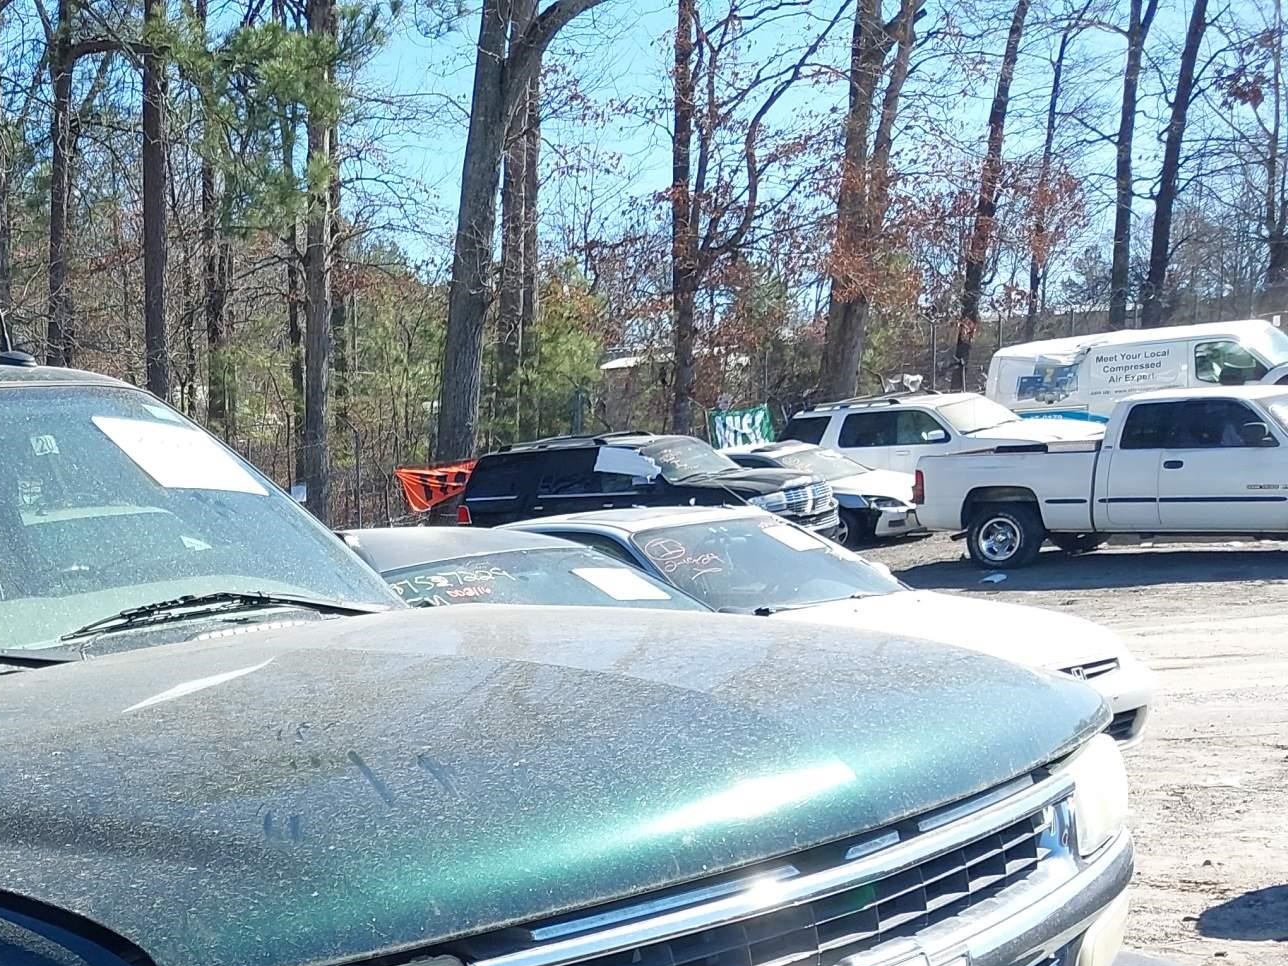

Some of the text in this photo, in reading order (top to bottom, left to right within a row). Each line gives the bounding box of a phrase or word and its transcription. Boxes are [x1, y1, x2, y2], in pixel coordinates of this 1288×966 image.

[1144, 349, 1170, 358] Local
[1102, 361, 1162, 374] Compressed
[1108, 372, 1155, 383] Air Expert
